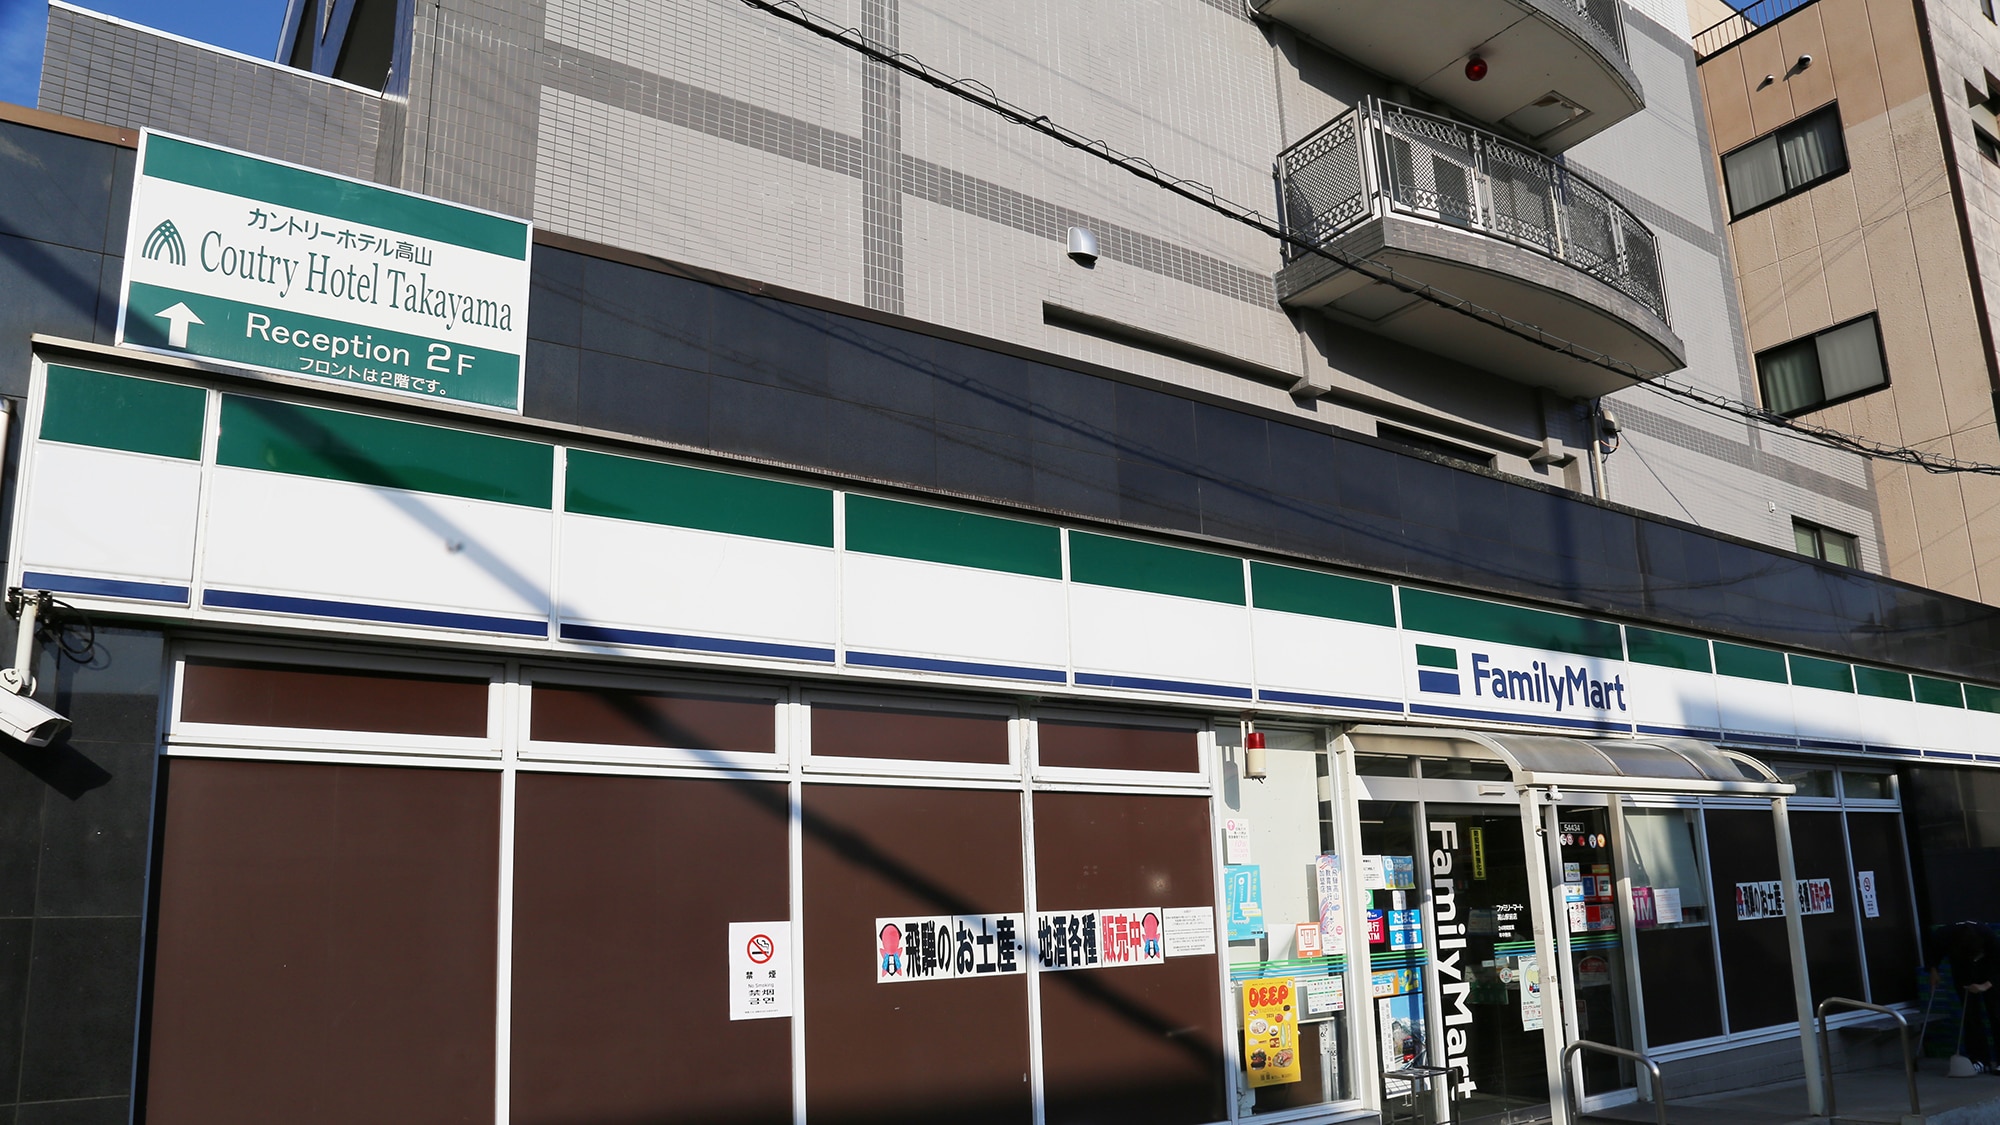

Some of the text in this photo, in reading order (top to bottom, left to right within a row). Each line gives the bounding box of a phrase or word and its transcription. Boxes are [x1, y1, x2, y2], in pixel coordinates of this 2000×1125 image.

[247, 208, 432, 266] カントリーホテル高山
[200, 230, 513, 331] Coutry Hotel Takayama
[246, 312, 475, 376] Reception 2F
[298, 356, 448, 396] フロントは2階です。
[1472, 653, 1627, 711] FamilyMart
[1393, 911, 1416, 925] たばこ
[1429, 822, 1478, 1102] FamilyMart
[1248, 984, 1289, 1009] DEEP
